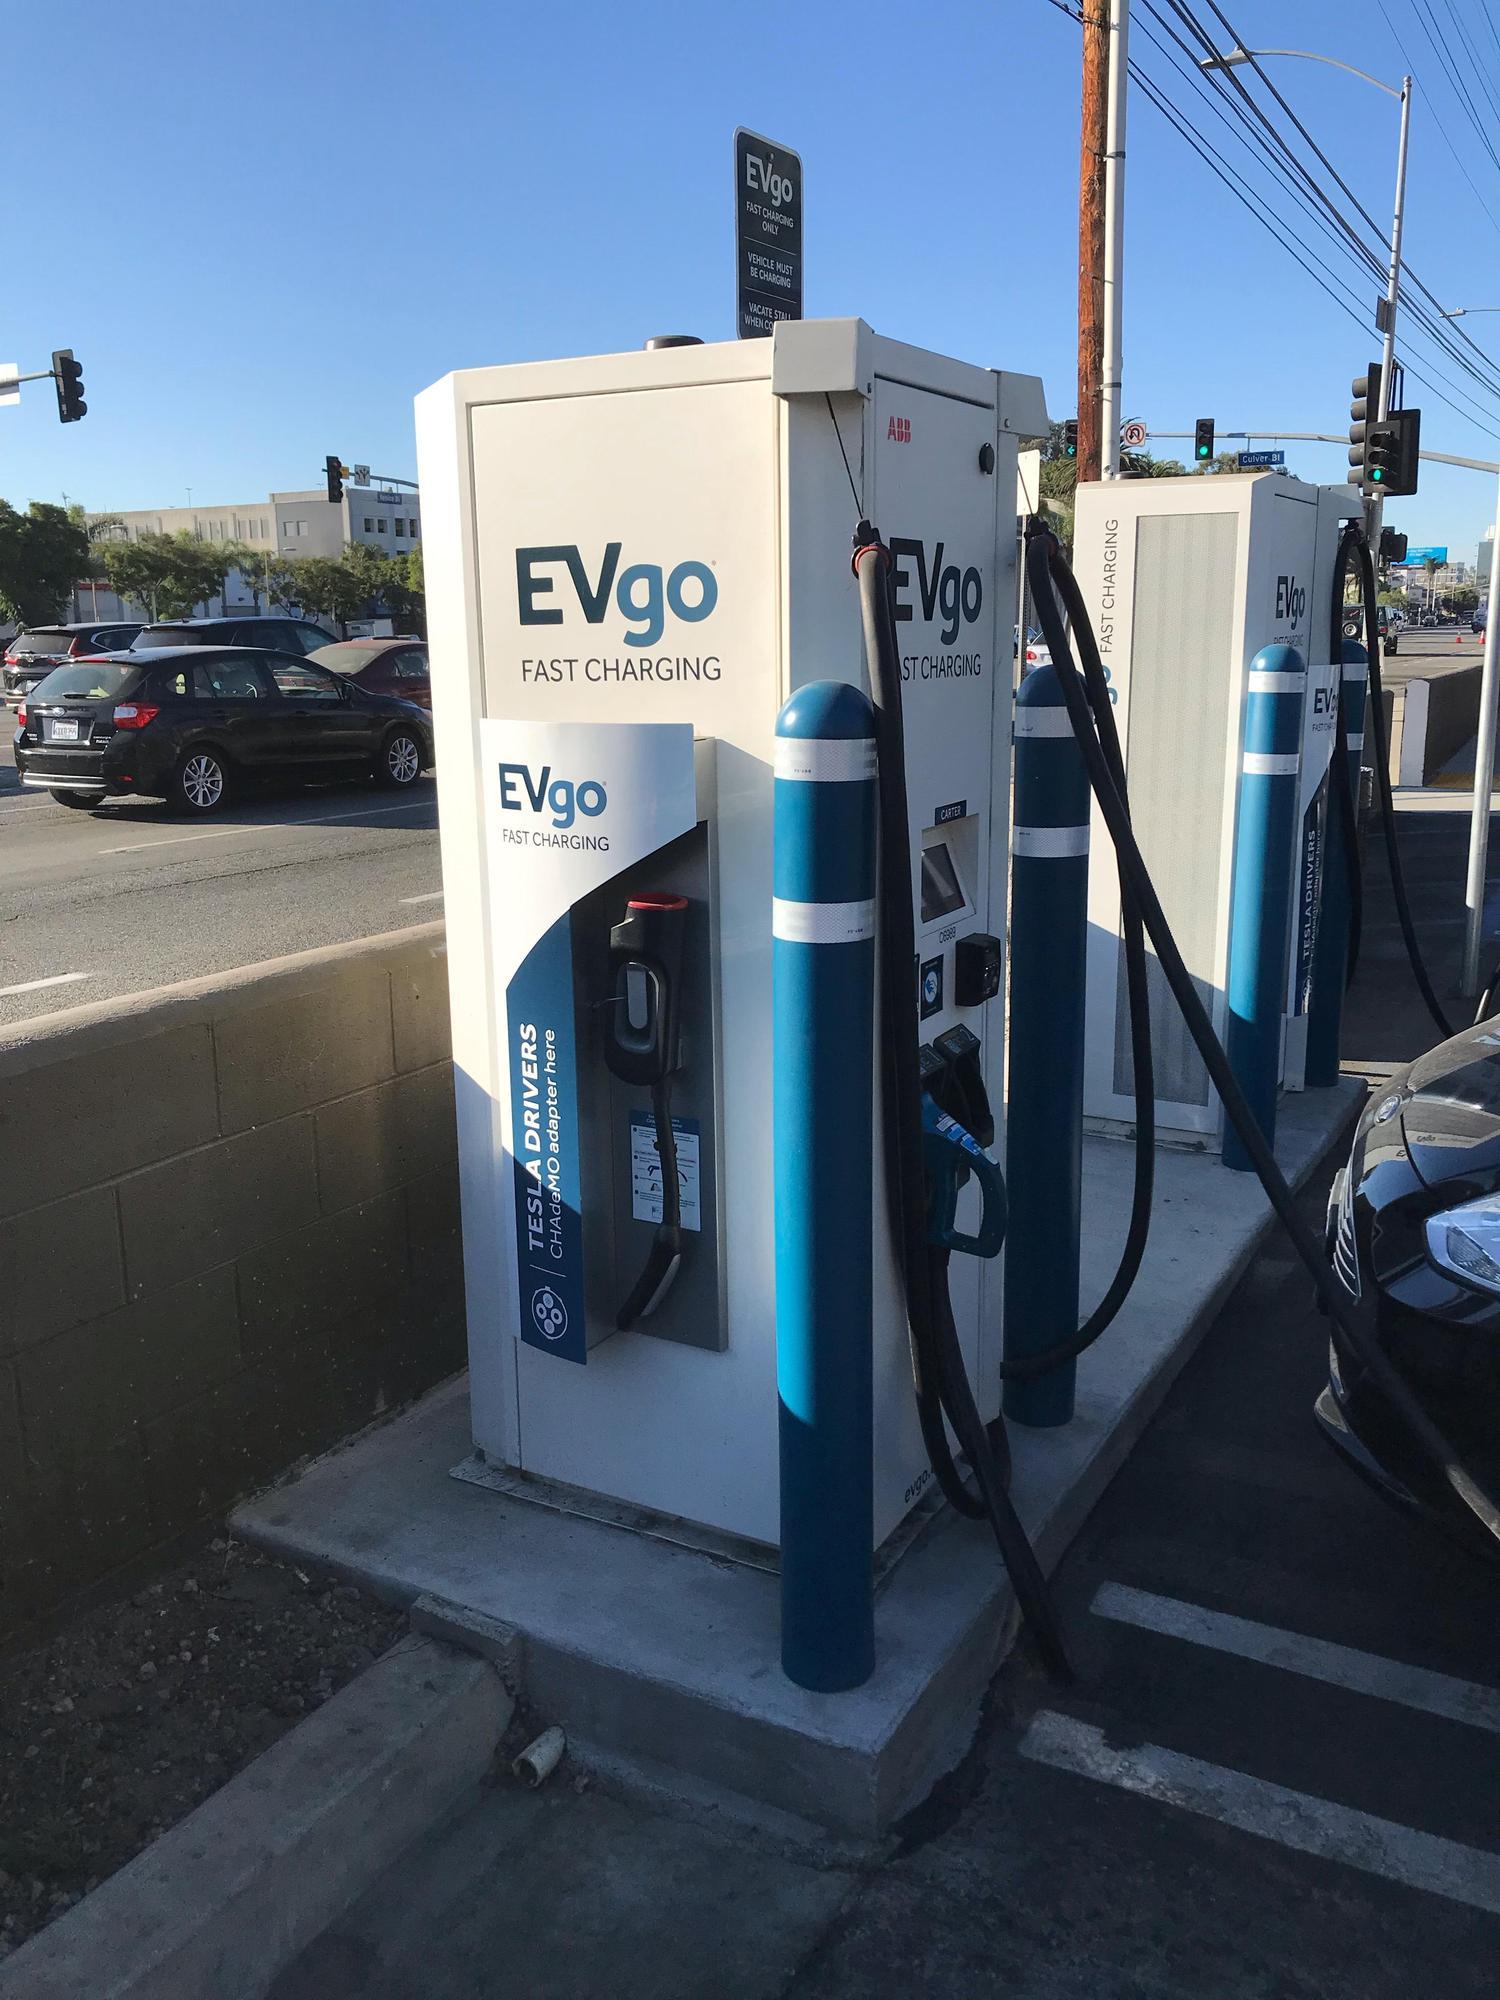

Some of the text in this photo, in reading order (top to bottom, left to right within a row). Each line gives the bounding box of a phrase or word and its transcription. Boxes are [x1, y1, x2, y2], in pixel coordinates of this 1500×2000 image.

[746, 153, 793, 207] EVgo
[746, 201, 794, 228] FAST CHARGING
[762, 221, 779, 235] ONLY
[747, 251, 793, 276] VEHICLE MUST
[750, 266, 791, 288] BE CHARGING
[744, 313, 764, 329] WHEN
[748, 301, 773, 319] VACATE
[887, 416, 912, 443] ABB
[1242, 453, 1280, 463] Culver Bl
[1102, 519, 1119, 610] CHARGING
[515, 542, 718, 648] EVgo
[889, 537, 982, 646] EVgo
[1275, 575, 1306, 630] EVgo
[1100, 613, 1114, 653] FAST
[521, 656, 722, 682] FAST CHARGING
[901, 653, 982, 681] ST CHARGING
[498, 763, 608, 829] EVgo
[941, 806, 961, 820] CARTER
[502, 828, 610, 852] FAST CHARGING
[1305, 830, 1316, 903] DRIVERS
[1302, 905, 1313, 960] TESLA
[520, 1023, 544, 1251] TESLA DRIVERS
[543, 1029, 563, 1259] CHAdeMO adapter here
